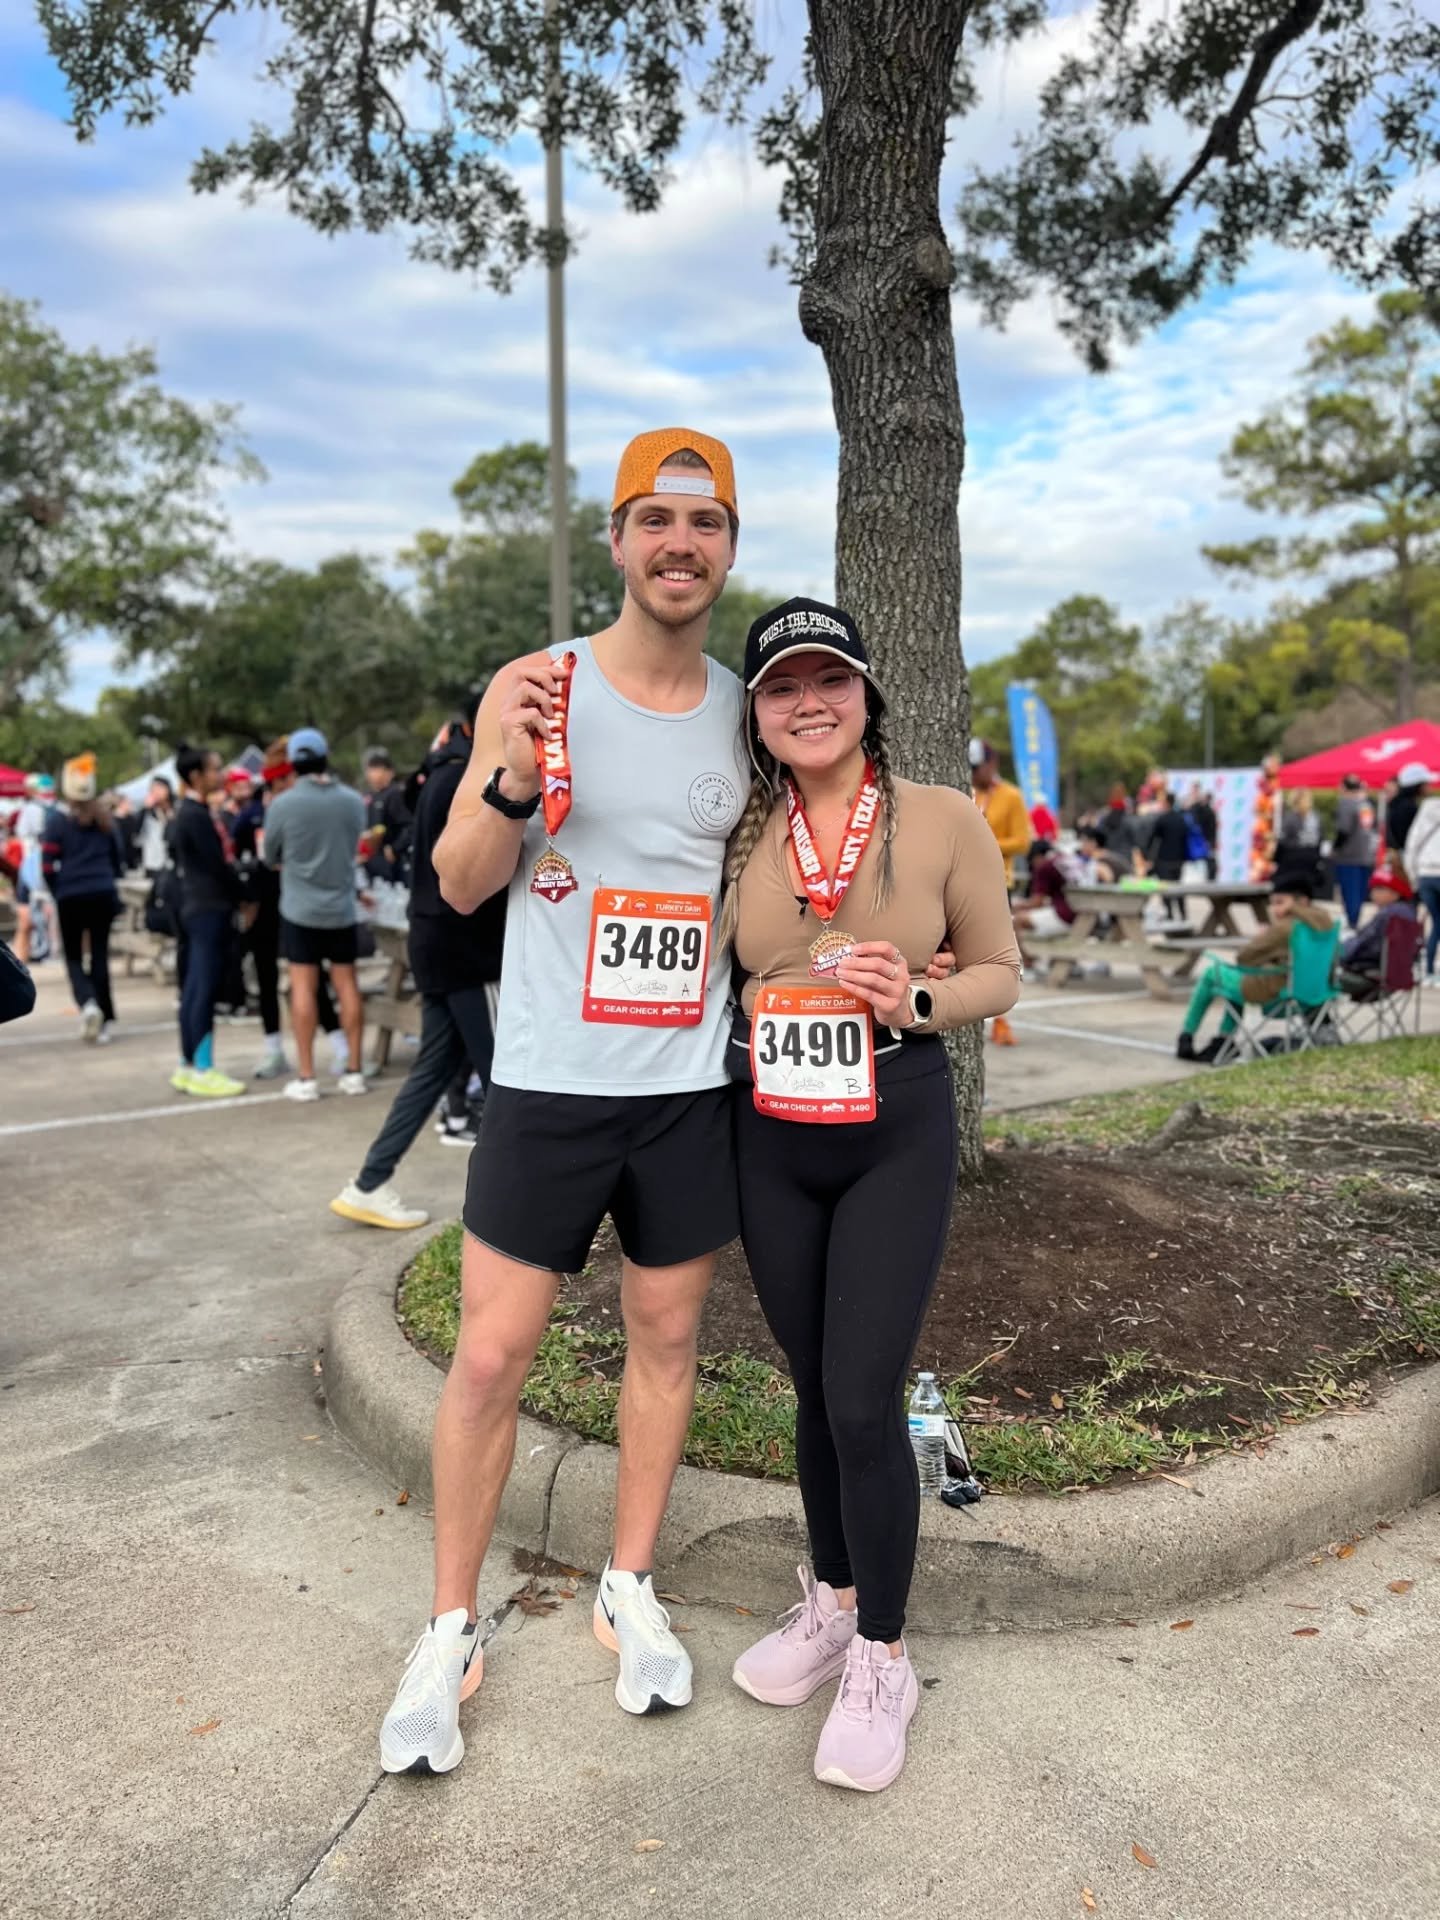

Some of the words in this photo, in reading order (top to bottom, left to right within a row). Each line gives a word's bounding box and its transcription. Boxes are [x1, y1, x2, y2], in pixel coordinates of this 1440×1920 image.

[759, 617, 785, 652] TRUST
[786, 612, 807, 628] THE
[808, 611, 850, 642] PROCESS
[850, 783, 879, 830] TEXAS
[791, 811, 822, 878] FINISHER
[838, 833, 870, 875] KATY,
[543, 872, 562, 881] YMCA
[655, 903, 684, 912] TURKEY
[684, 904, 702, 913] DASH
[601, 923, 702, 971] 3489
[823, 947, 847, 961] YMCA
[681, 983, 690, 997] A
[604, 1004, 628, 1013] GEAR
[629, 1006, 659, 1015] CHECK
[800, 999, 832, 1007] TURKEY
[833, 998, 856, 1006] DASH
[759, 1020, 862, 1068] 3490
[844, 1078, 861, 1094] B
[769, 1100, 789, 1110] GEAR
[790, 1103, 818, 1112] CHECK
[849, 1103, 870, 1112] 3490
